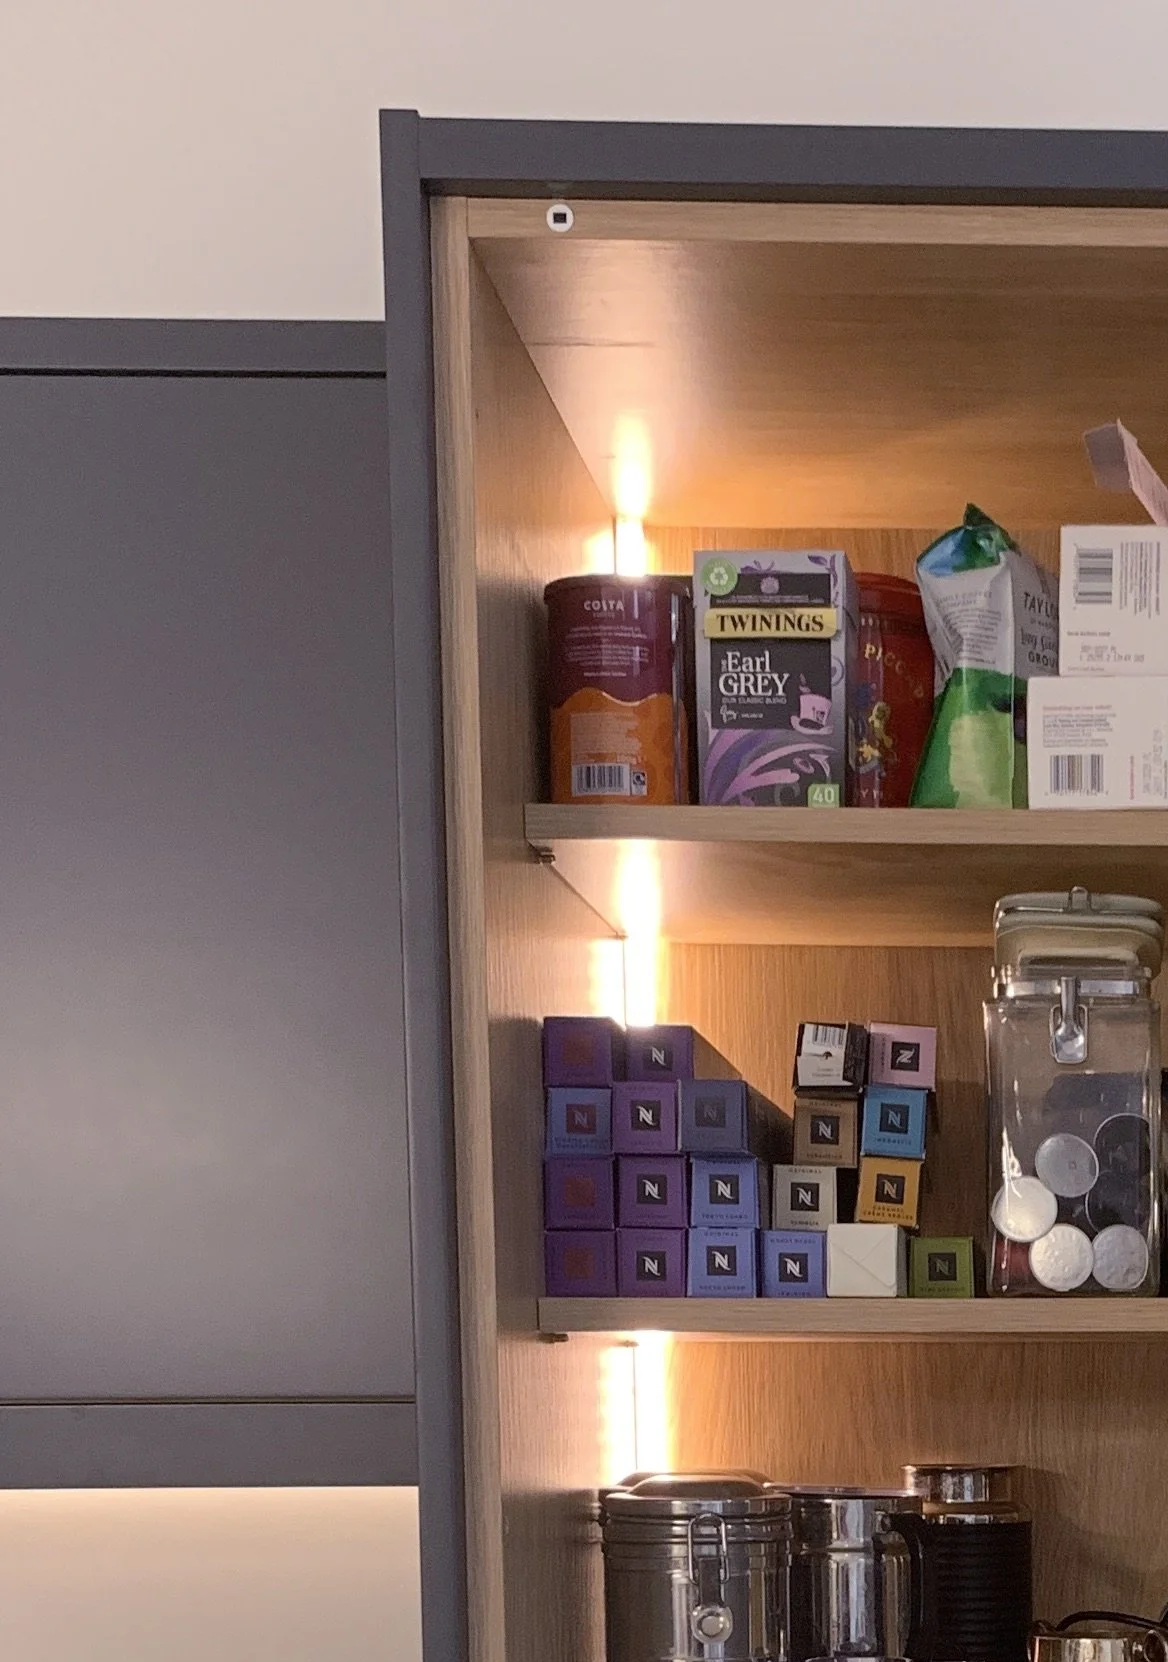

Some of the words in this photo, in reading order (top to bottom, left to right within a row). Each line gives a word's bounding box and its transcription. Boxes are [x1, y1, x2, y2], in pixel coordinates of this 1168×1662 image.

[583, 600, 625, 611] COSTA
[716, 614, 824, 632] TWININGS
[727, 650, 771, 672] Earl
[719, 673, 790, 696] GREY
[813, 788, 835, 802] 40
